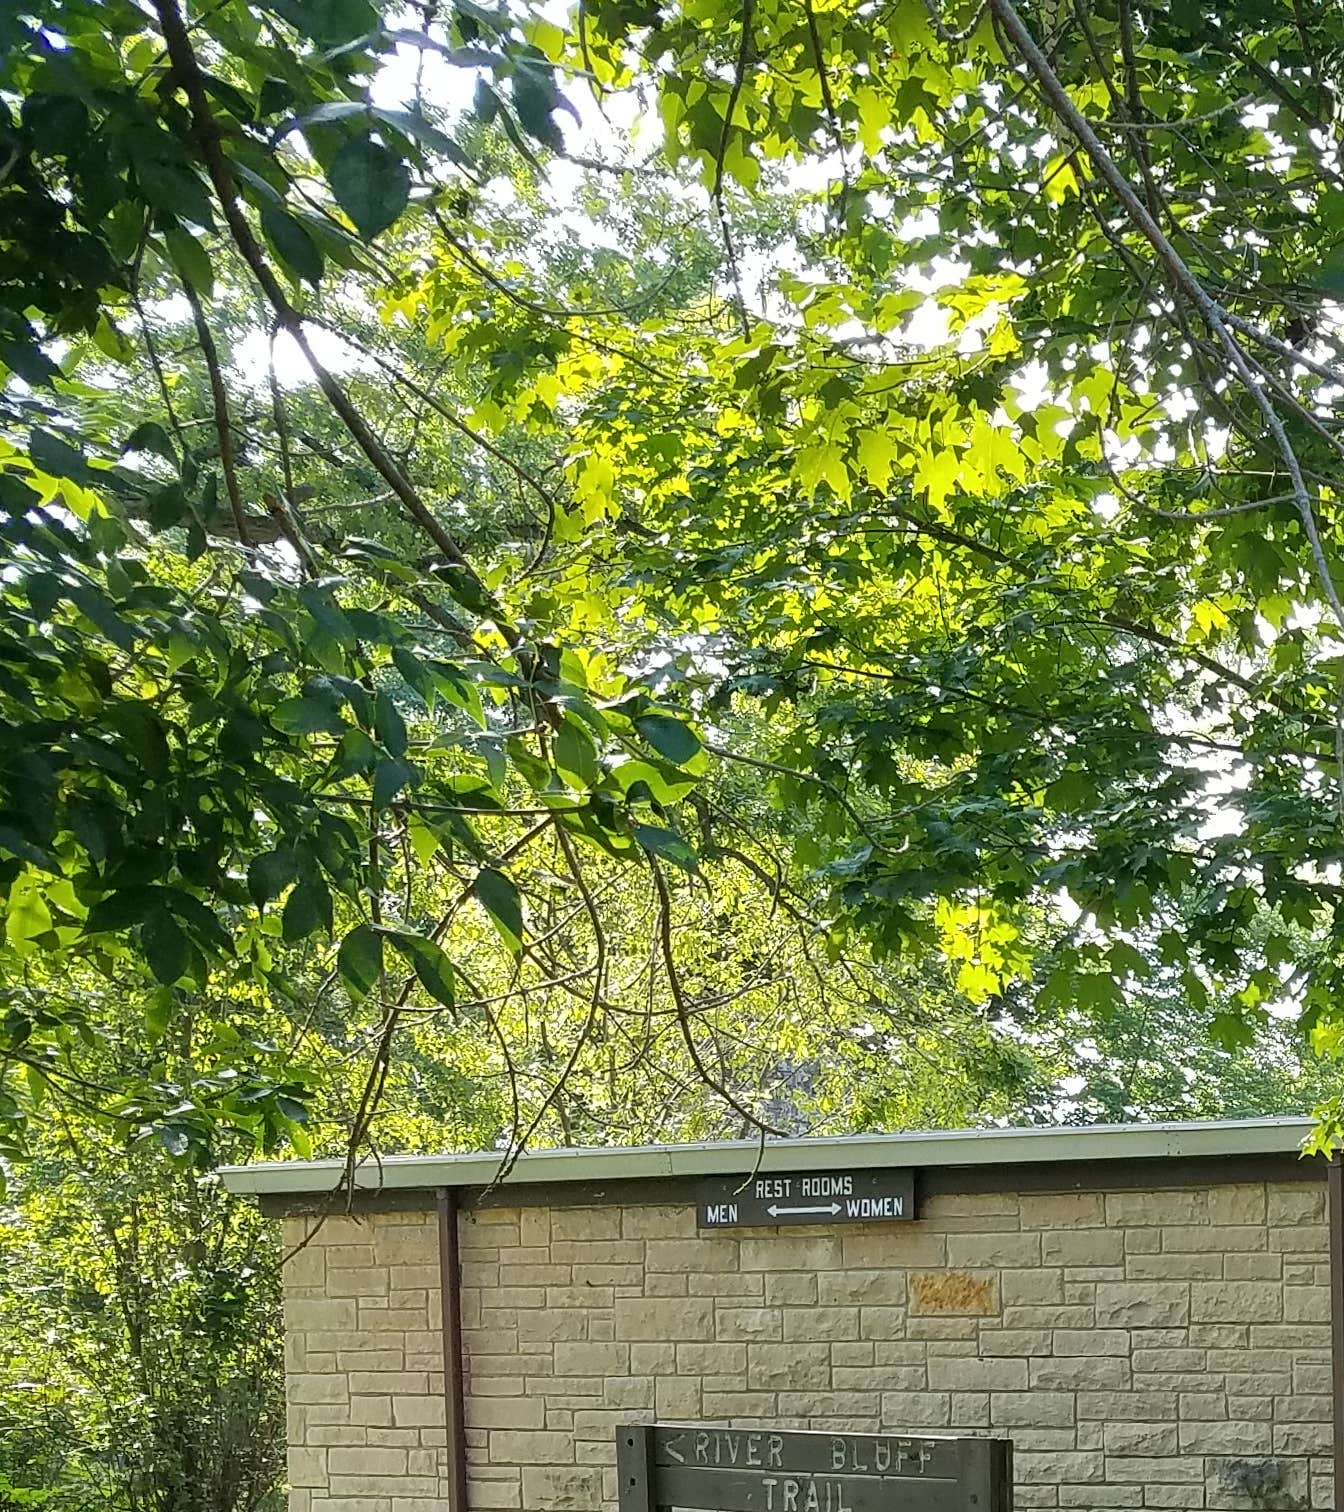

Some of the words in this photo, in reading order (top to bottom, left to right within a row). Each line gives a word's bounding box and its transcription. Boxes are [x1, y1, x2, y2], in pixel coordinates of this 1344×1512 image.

[755, 1179, 792, 1199] REST
[802, 1176, 853, 1196] ROOMS
[706, 1204, 738, 1223] MEN
[846, 1197, 904, 1218] WOMEN
[695, 1432, 784, 1467] RIVER
[830, 1438, 936, 1473] BLUFF
